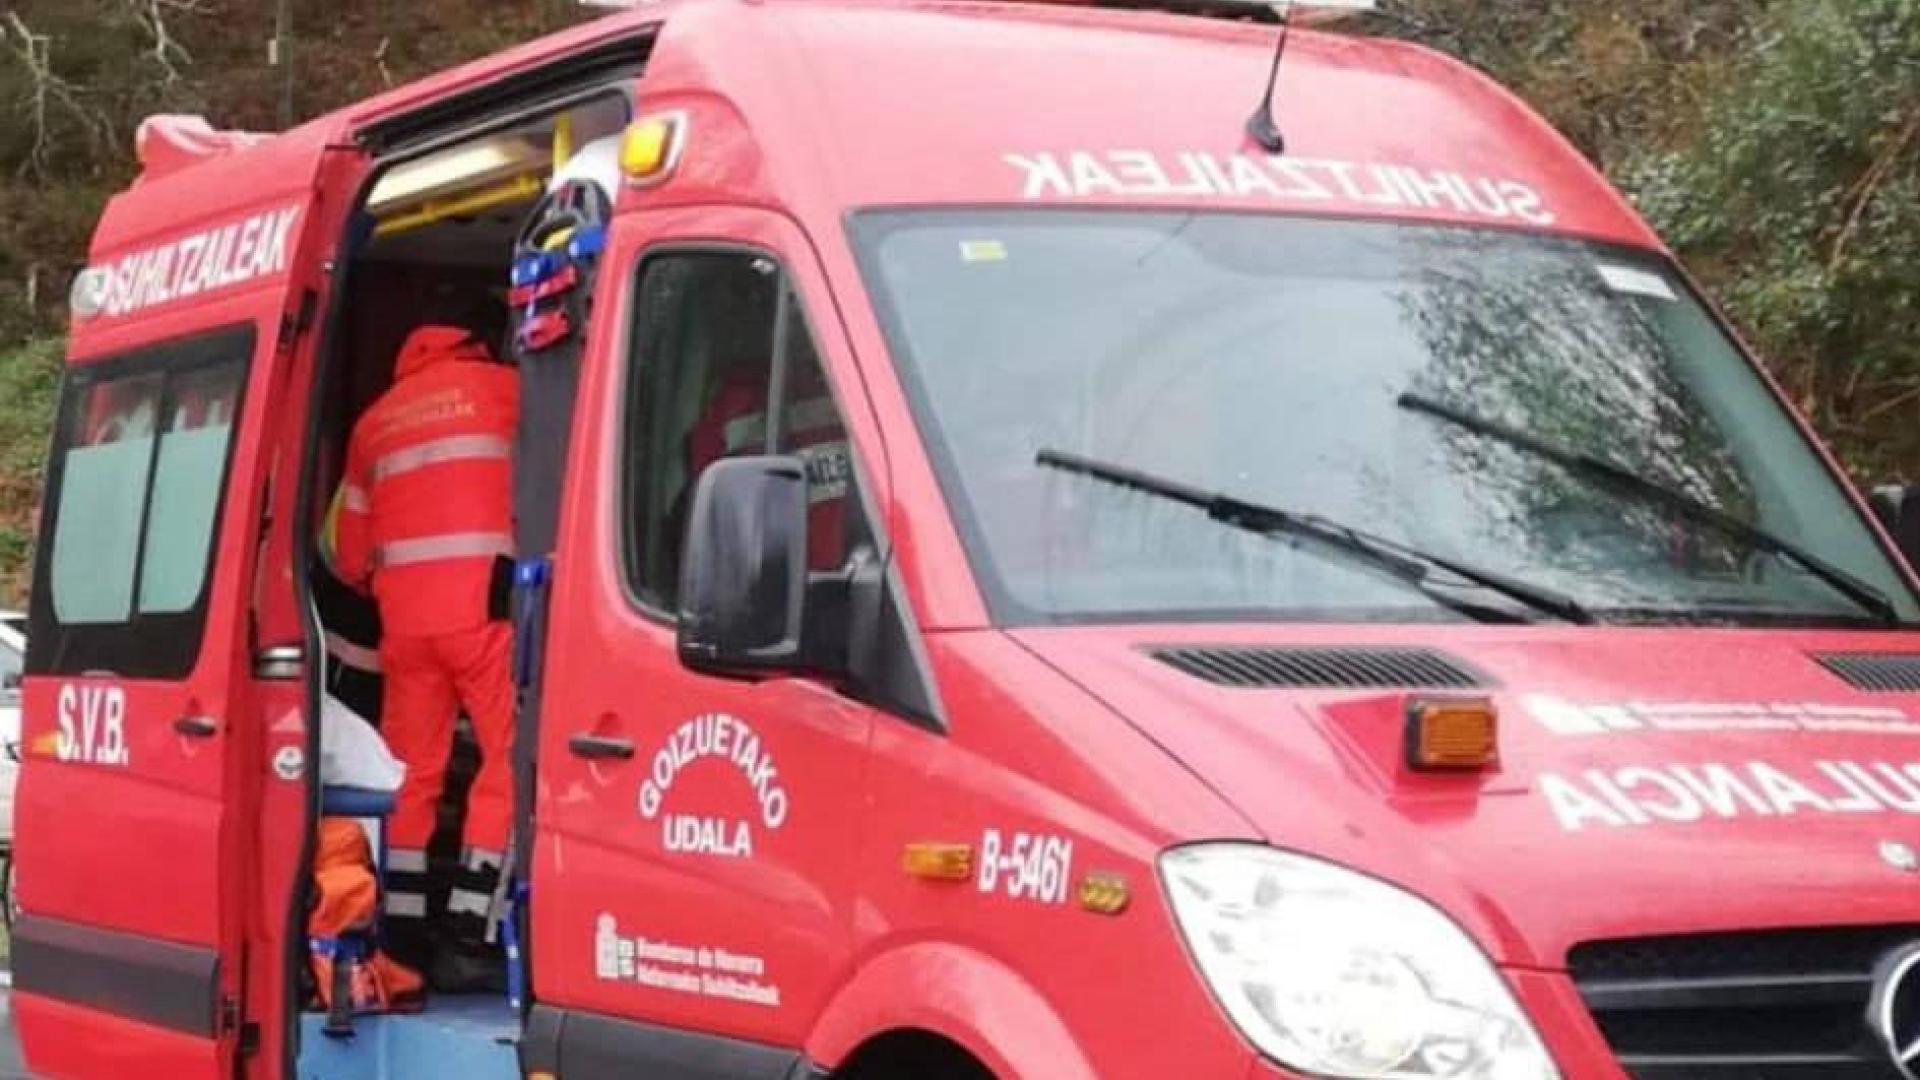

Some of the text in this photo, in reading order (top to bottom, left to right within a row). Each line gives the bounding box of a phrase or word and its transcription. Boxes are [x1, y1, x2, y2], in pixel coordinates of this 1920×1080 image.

[104, 204, 300, 316] SUHILTZAILEAK
[57, 683, 129, 767] S.V.B.
[639, 712, 788, 829] GOIZUETAKO
[663, 813, 753, 857] UDALA
[978, 828, 1074, 904] B-5461
